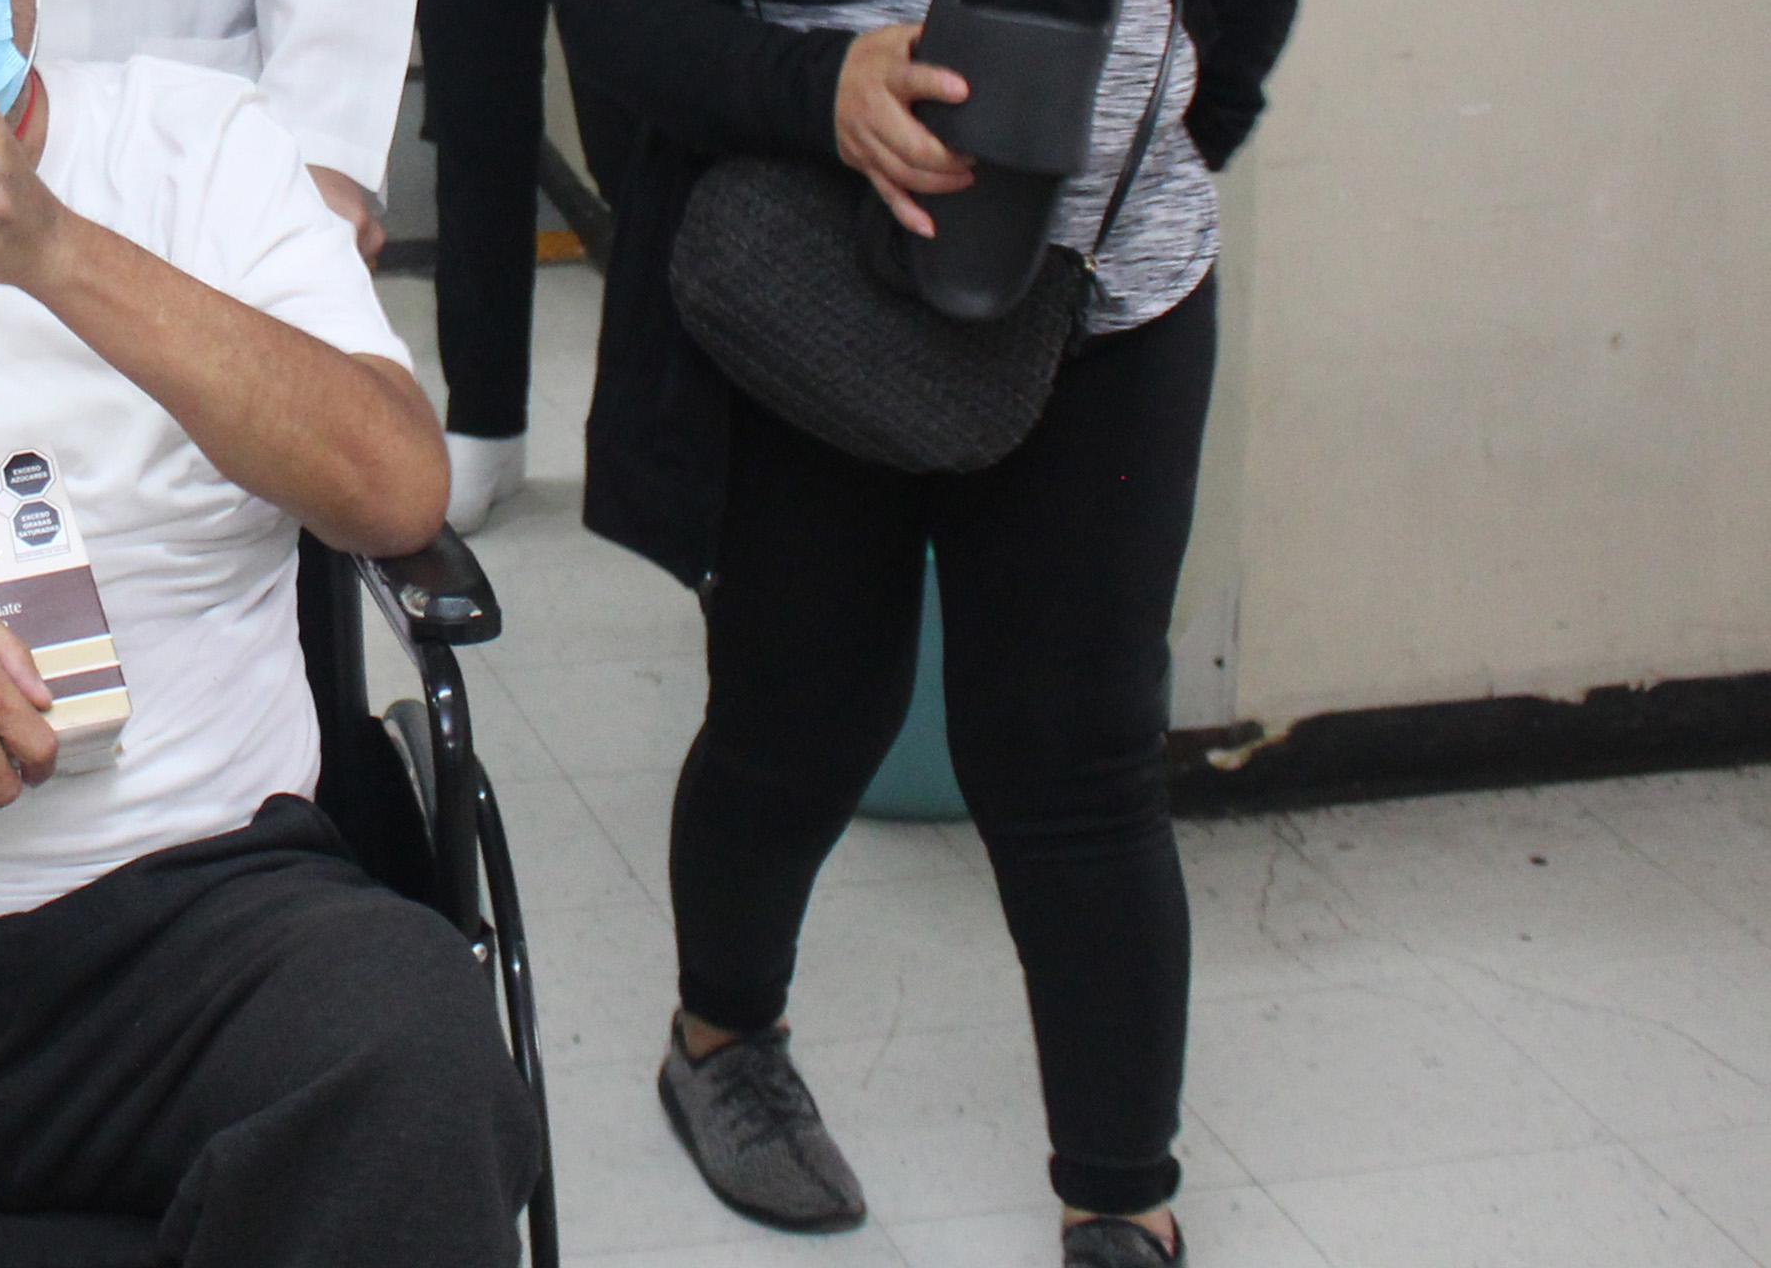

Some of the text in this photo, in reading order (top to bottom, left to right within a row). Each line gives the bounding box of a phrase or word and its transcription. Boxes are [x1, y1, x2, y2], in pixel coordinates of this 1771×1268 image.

[13, 464, 42, 476] EXCESO
[21, 510, 50, 522] EXCESO
[22, 518, 52, 530] GRASAS
[18, 524, 60, 538] SATURADAS
